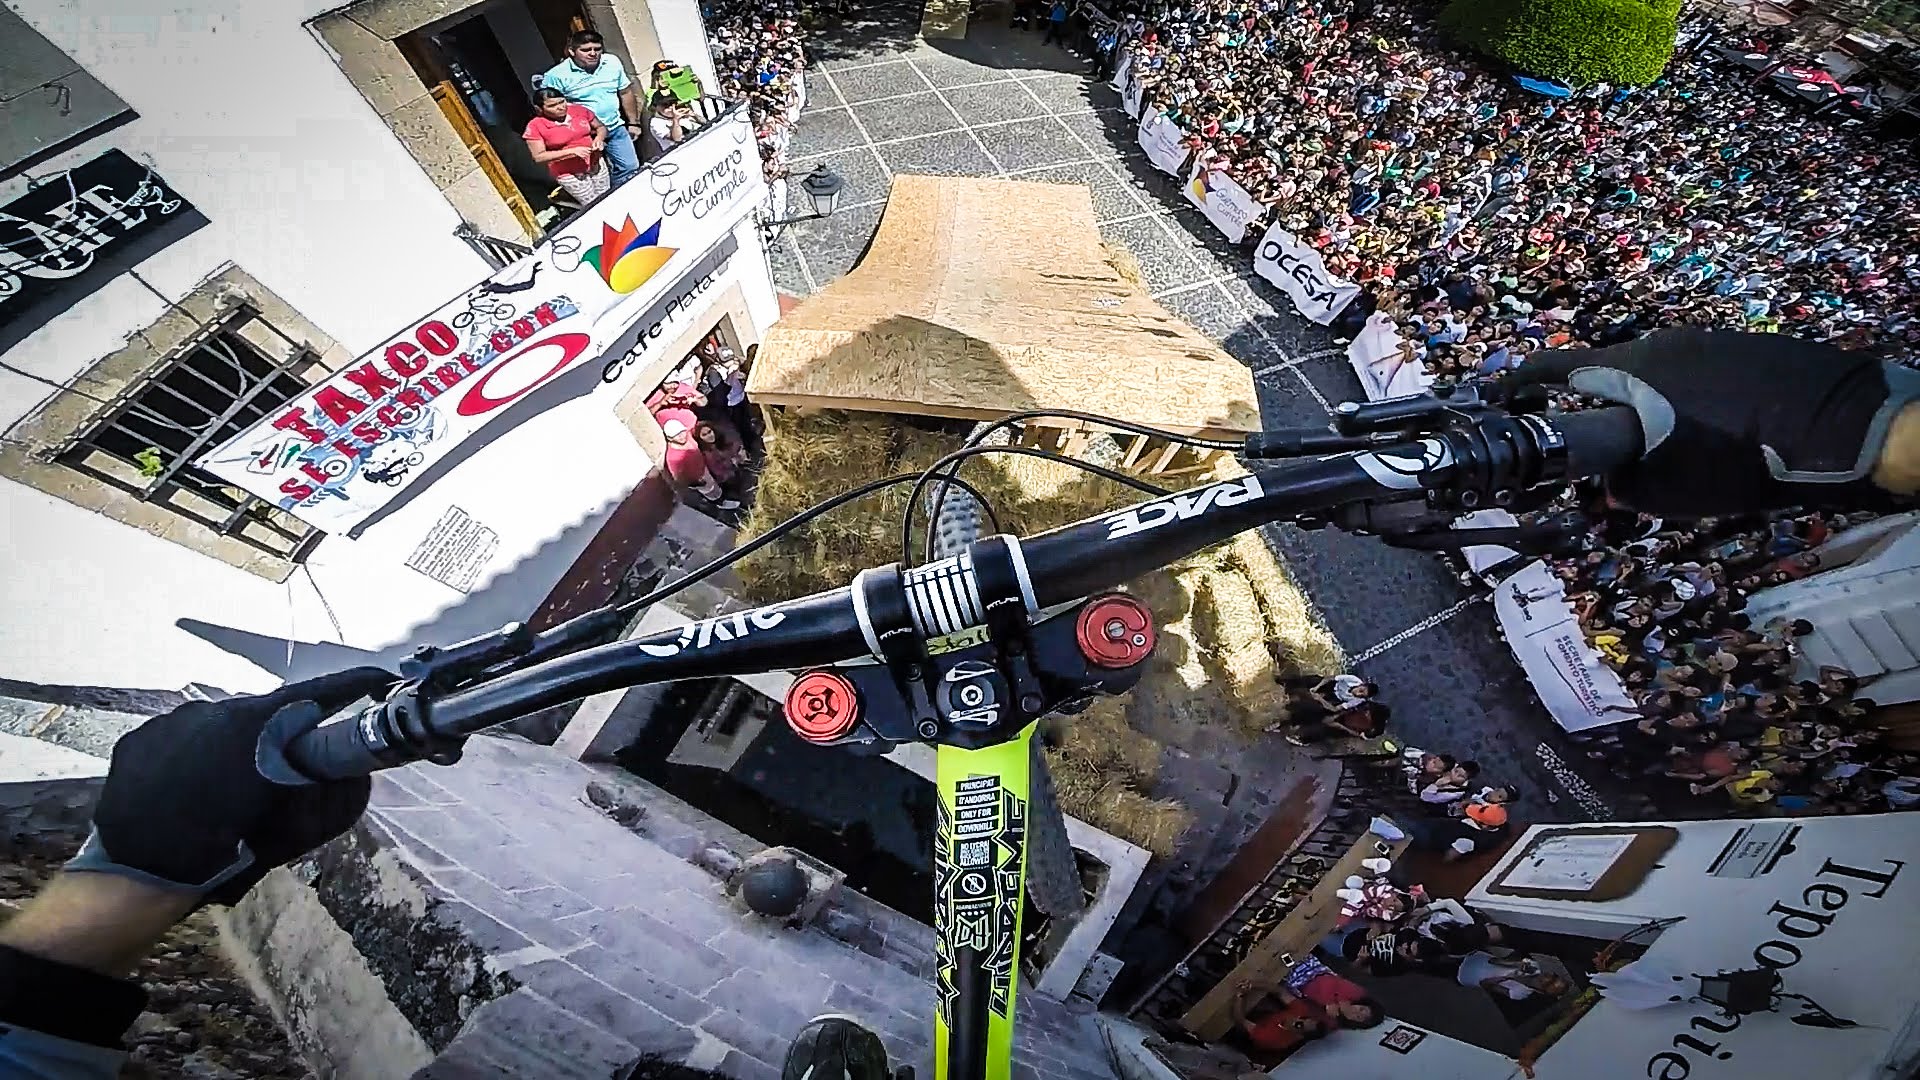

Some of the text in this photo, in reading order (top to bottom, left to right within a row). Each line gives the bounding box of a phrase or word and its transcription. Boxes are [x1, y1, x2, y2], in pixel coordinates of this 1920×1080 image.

[662, 149, 743, 217] Guerrero
[692, 169, 748, 220] Cumple
[665, 271, 715, 325] Plata
[1262, 240, 1337, 312] OCESA
[490, 301, 558, 353] CON
[271, 320, 459, 444] TAXCO
[1103, 475, 1265, 541] RACE
[1554, 637, 1580, 680] FOMENTO
[1589, 688, 1603, 703] DE
[958, 792, 996, 805] D'ANDORRA
[960, 778, 995, 791] PRINCIPAT
[957, 821, 995, 834] DOWNHILL
[960, 807, 992, 819] ONLY FOR
